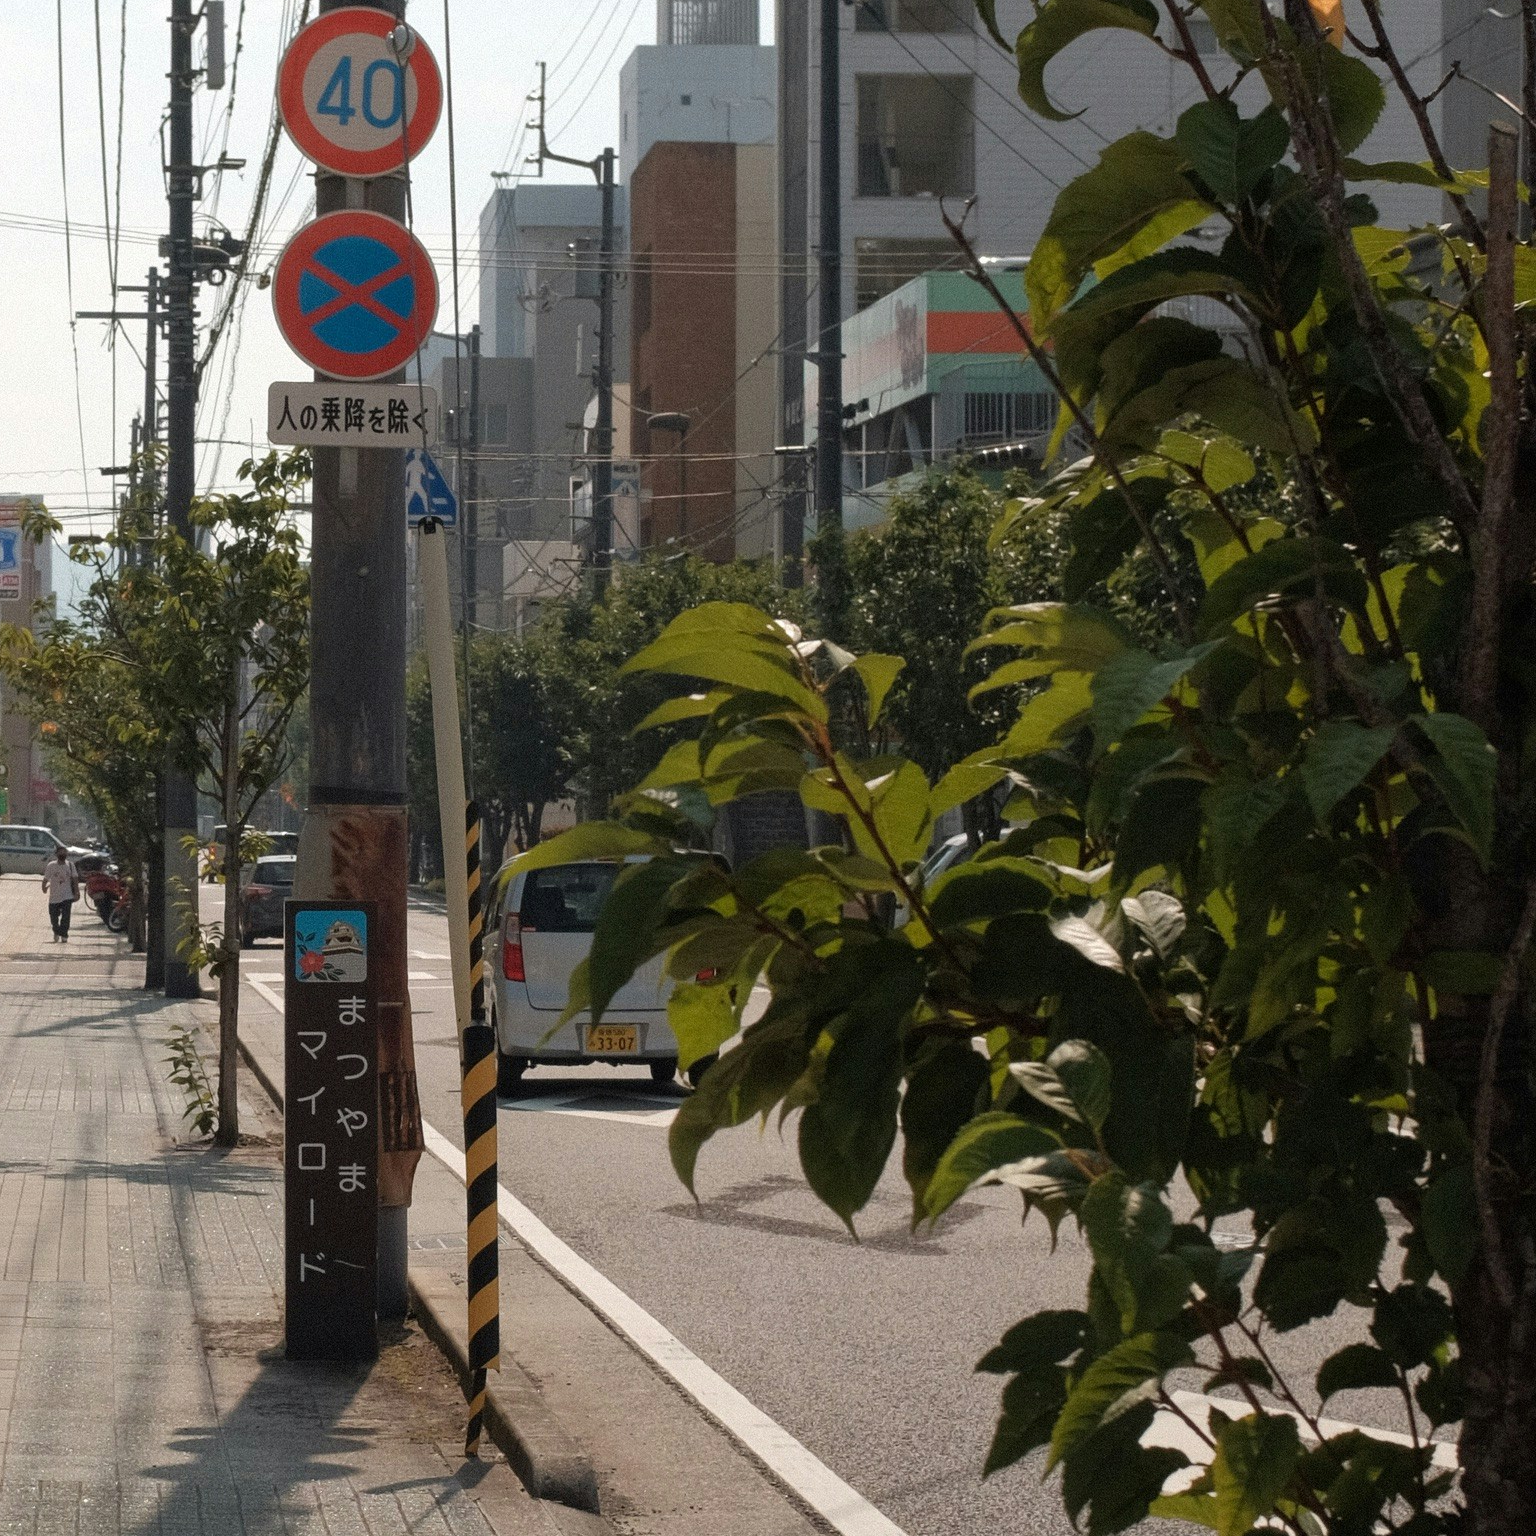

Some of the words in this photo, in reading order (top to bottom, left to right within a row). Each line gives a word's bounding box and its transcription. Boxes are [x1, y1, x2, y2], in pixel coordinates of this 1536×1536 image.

[316, 55, 403, 129] 40
[276, 396, 428, 434] 人の乗降を除く
[297, 1030, 328, 1283] マイロード
[336, 995, 369, 1193] まつやま
